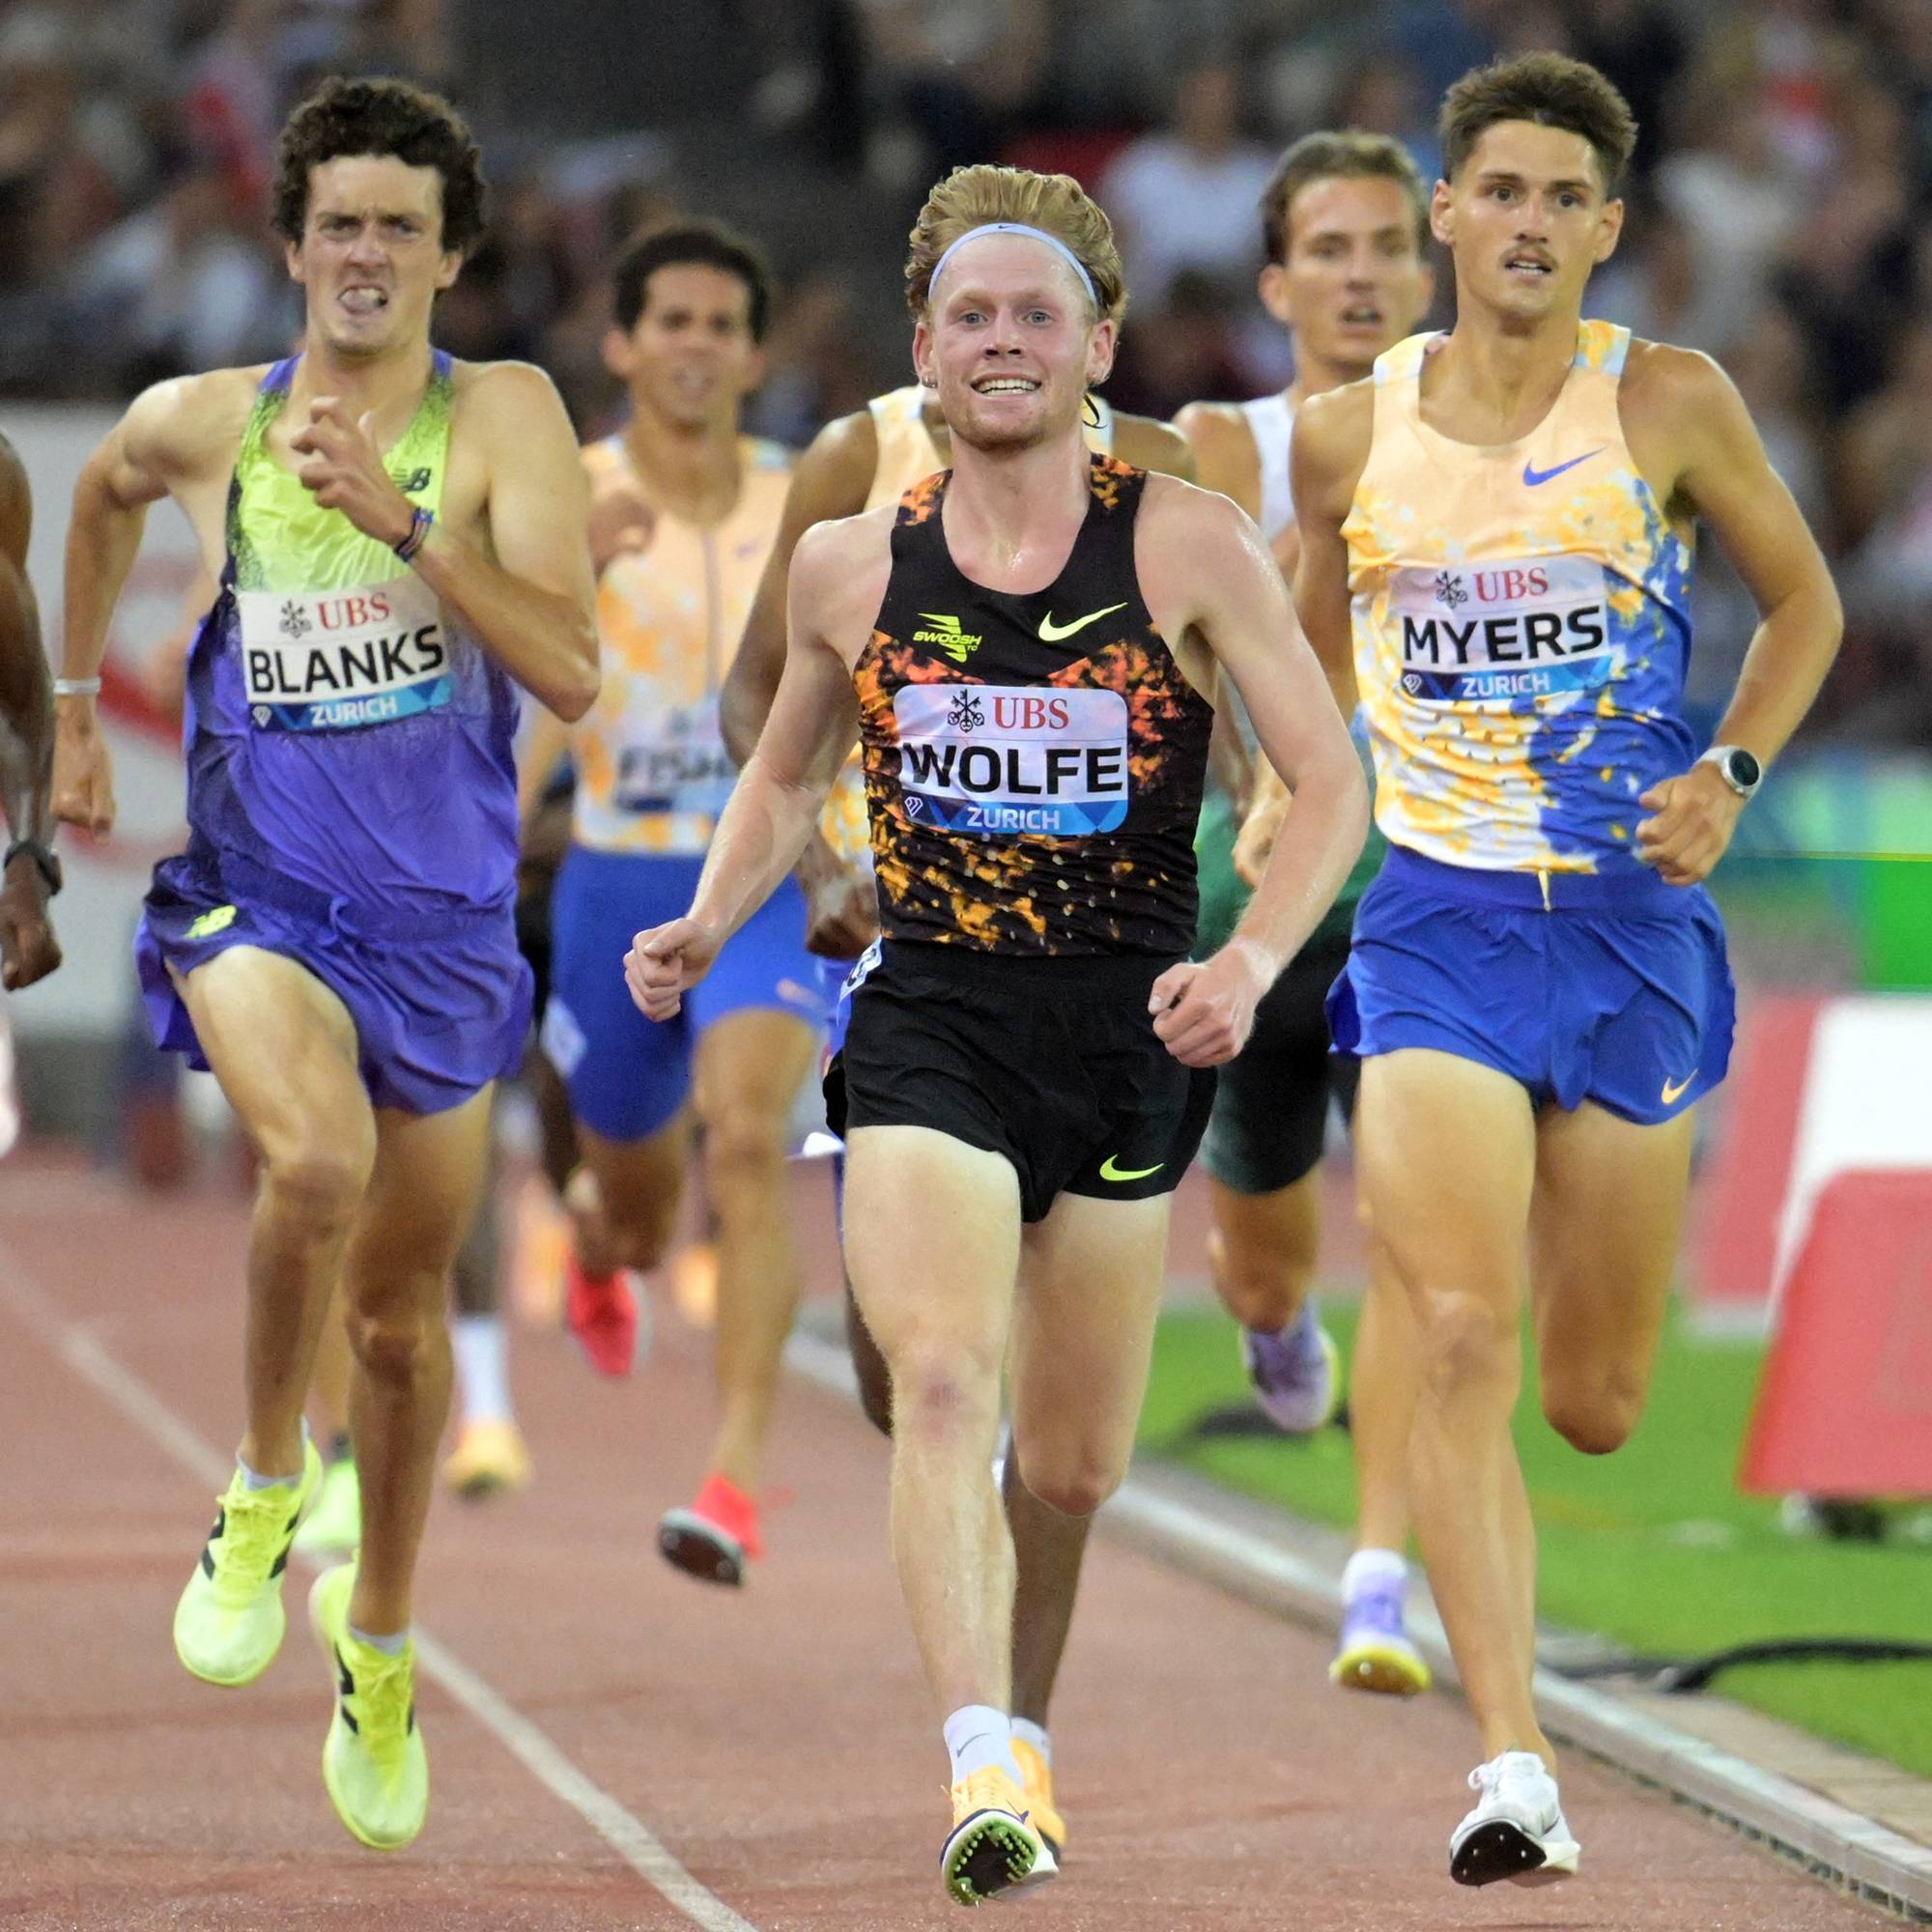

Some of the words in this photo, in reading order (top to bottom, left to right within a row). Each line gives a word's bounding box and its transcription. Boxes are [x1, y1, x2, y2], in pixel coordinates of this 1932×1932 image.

[1473, 567, 1549, 602] UBS
[317, 592, 390, 630] UBS
[913, 631, 982, 645] SWOOSH
[1404, 605, 1604, 665] MYERS
[248, 625, 443, 693] BLANKS
[1462, 672, 1550, 697] ZURICH
[310, 696, 397, 725] ZURICH
[992, 696, 1069, 730] UBS
[902, 742, 1122, 795] WOLFE
[966, 807, 1060, 830] ZURICH
